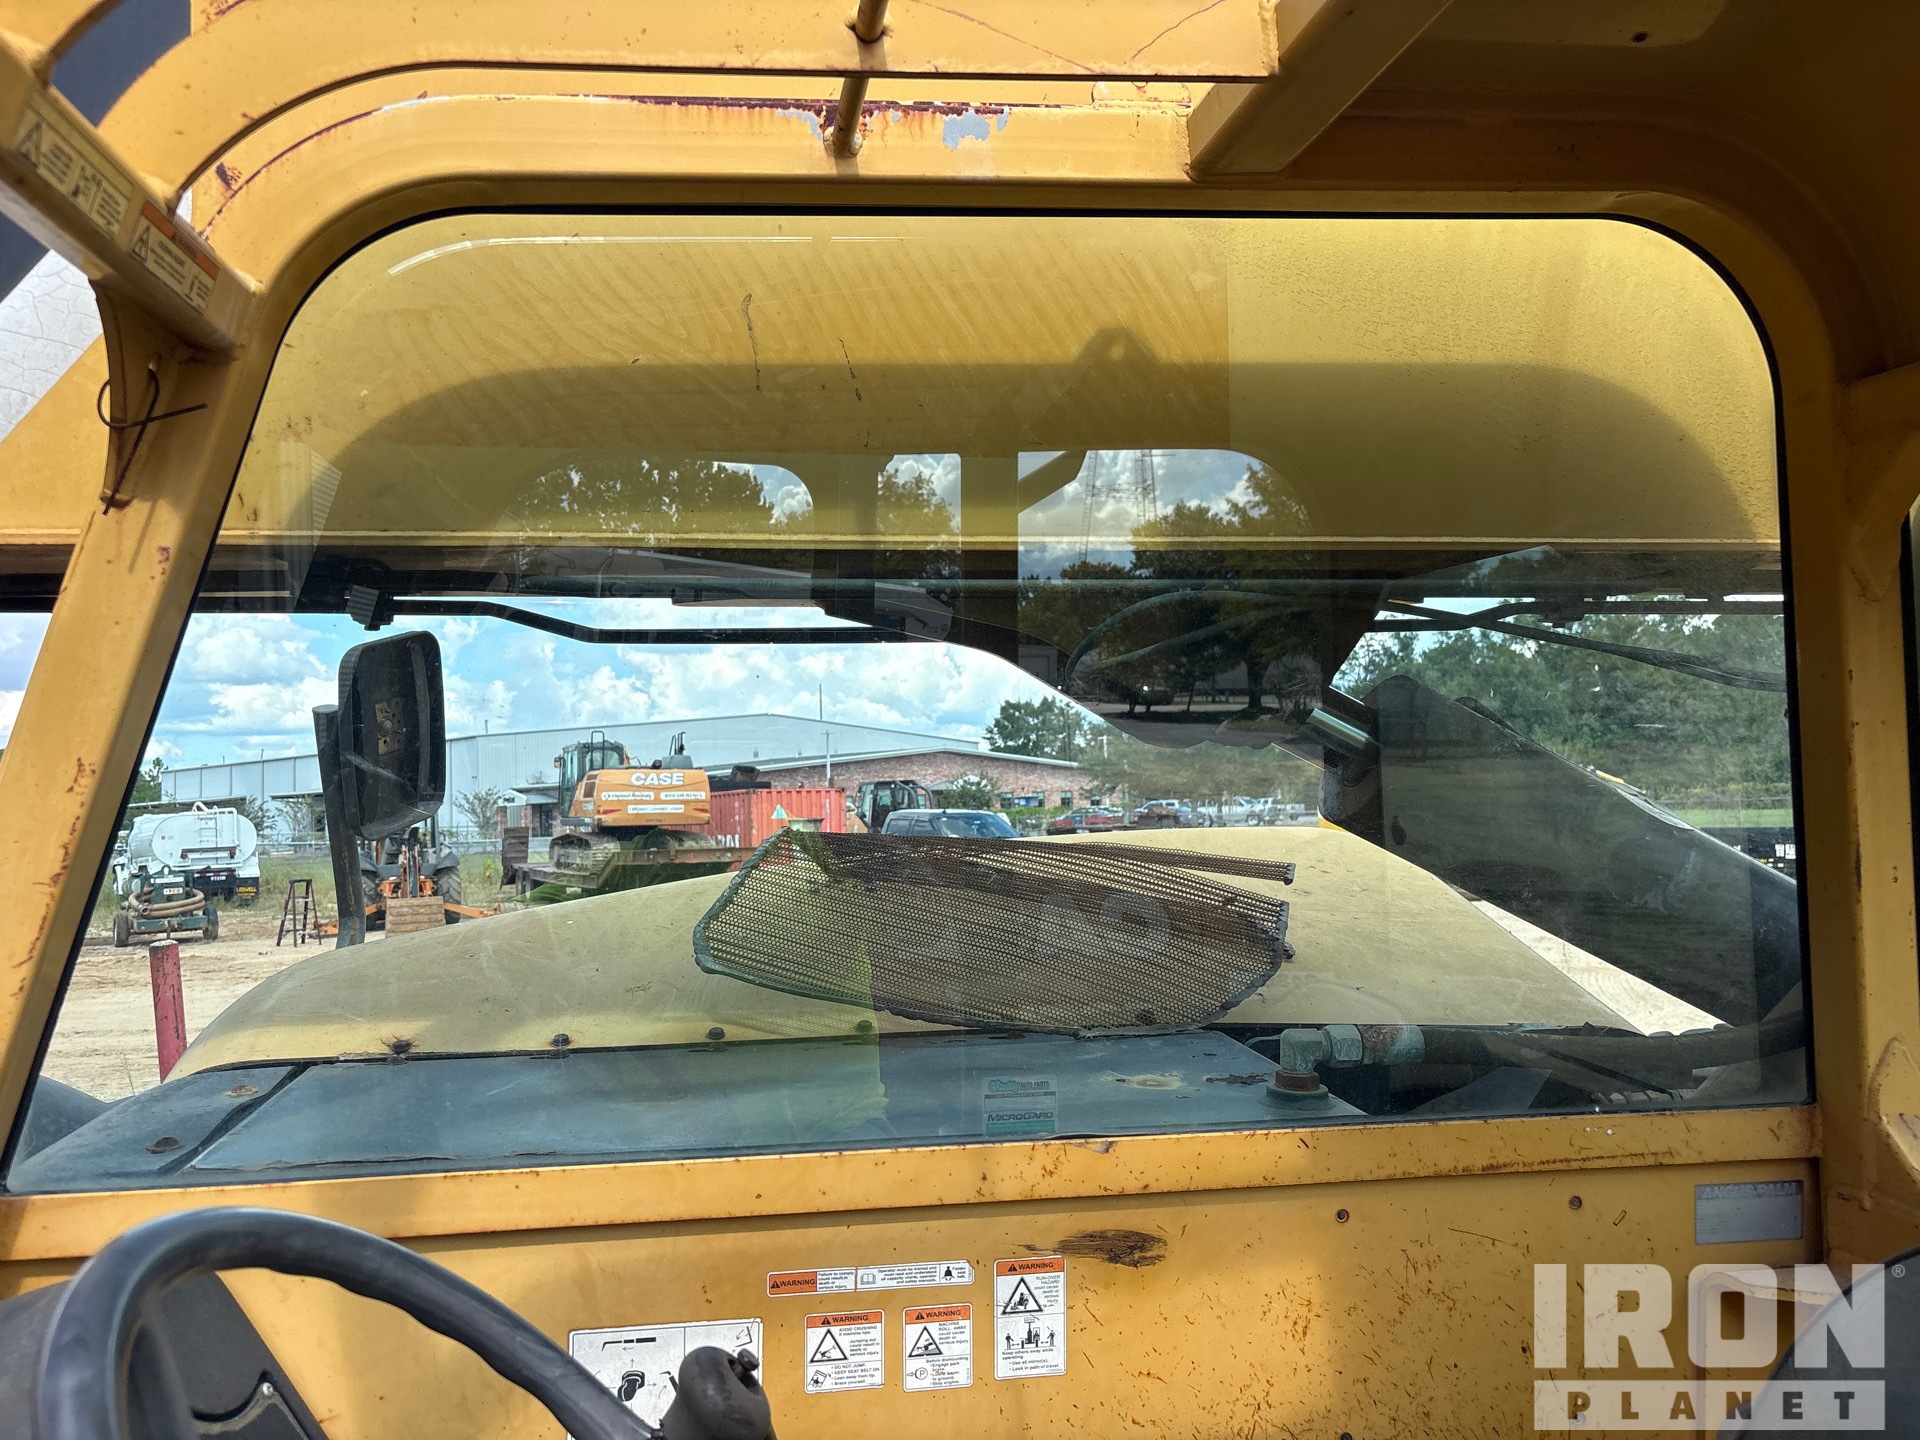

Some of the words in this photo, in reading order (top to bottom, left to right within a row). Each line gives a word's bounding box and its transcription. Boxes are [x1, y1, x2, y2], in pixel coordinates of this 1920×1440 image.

[630, 772, 684, 785] CASE
[1018, 1261, 1054, 1270] WARNING
[780, 1278, 816, 1287] WARNING
[926, 1310, 961, 1318] WARNING
[832, 1315, 868, 1323] WARNING
